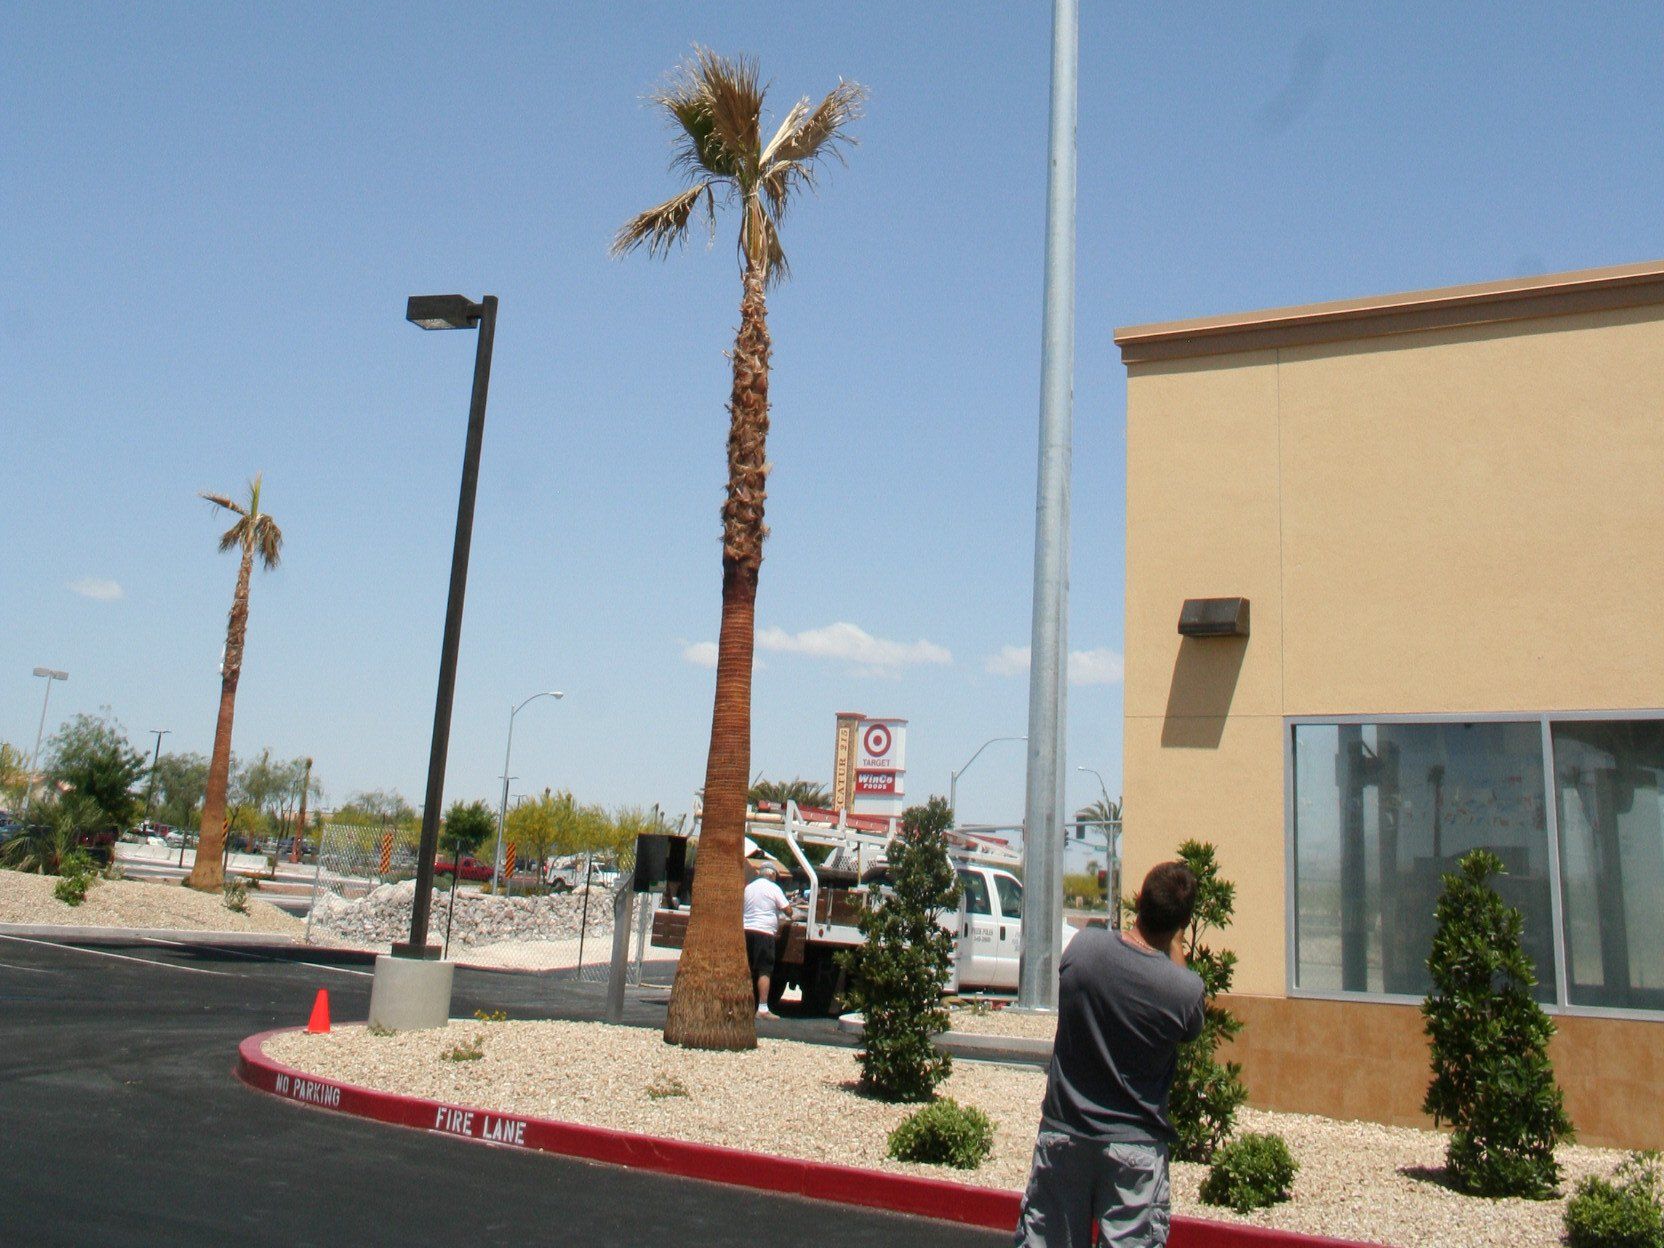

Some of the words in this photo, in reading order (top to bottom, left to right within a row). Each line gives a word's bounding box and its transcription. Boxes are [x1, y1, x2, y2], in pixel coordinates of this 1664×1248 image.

[863, 758, 890, 767] TARGET
[858, 773, 893, 784] WinCo
[276, 1073, 289, 1093] NO
[293, 1078, 340, 1107] PARKING
[435, 1106, 474, 1136] FIRE
[483, 1115, 527, 1144] LANE
